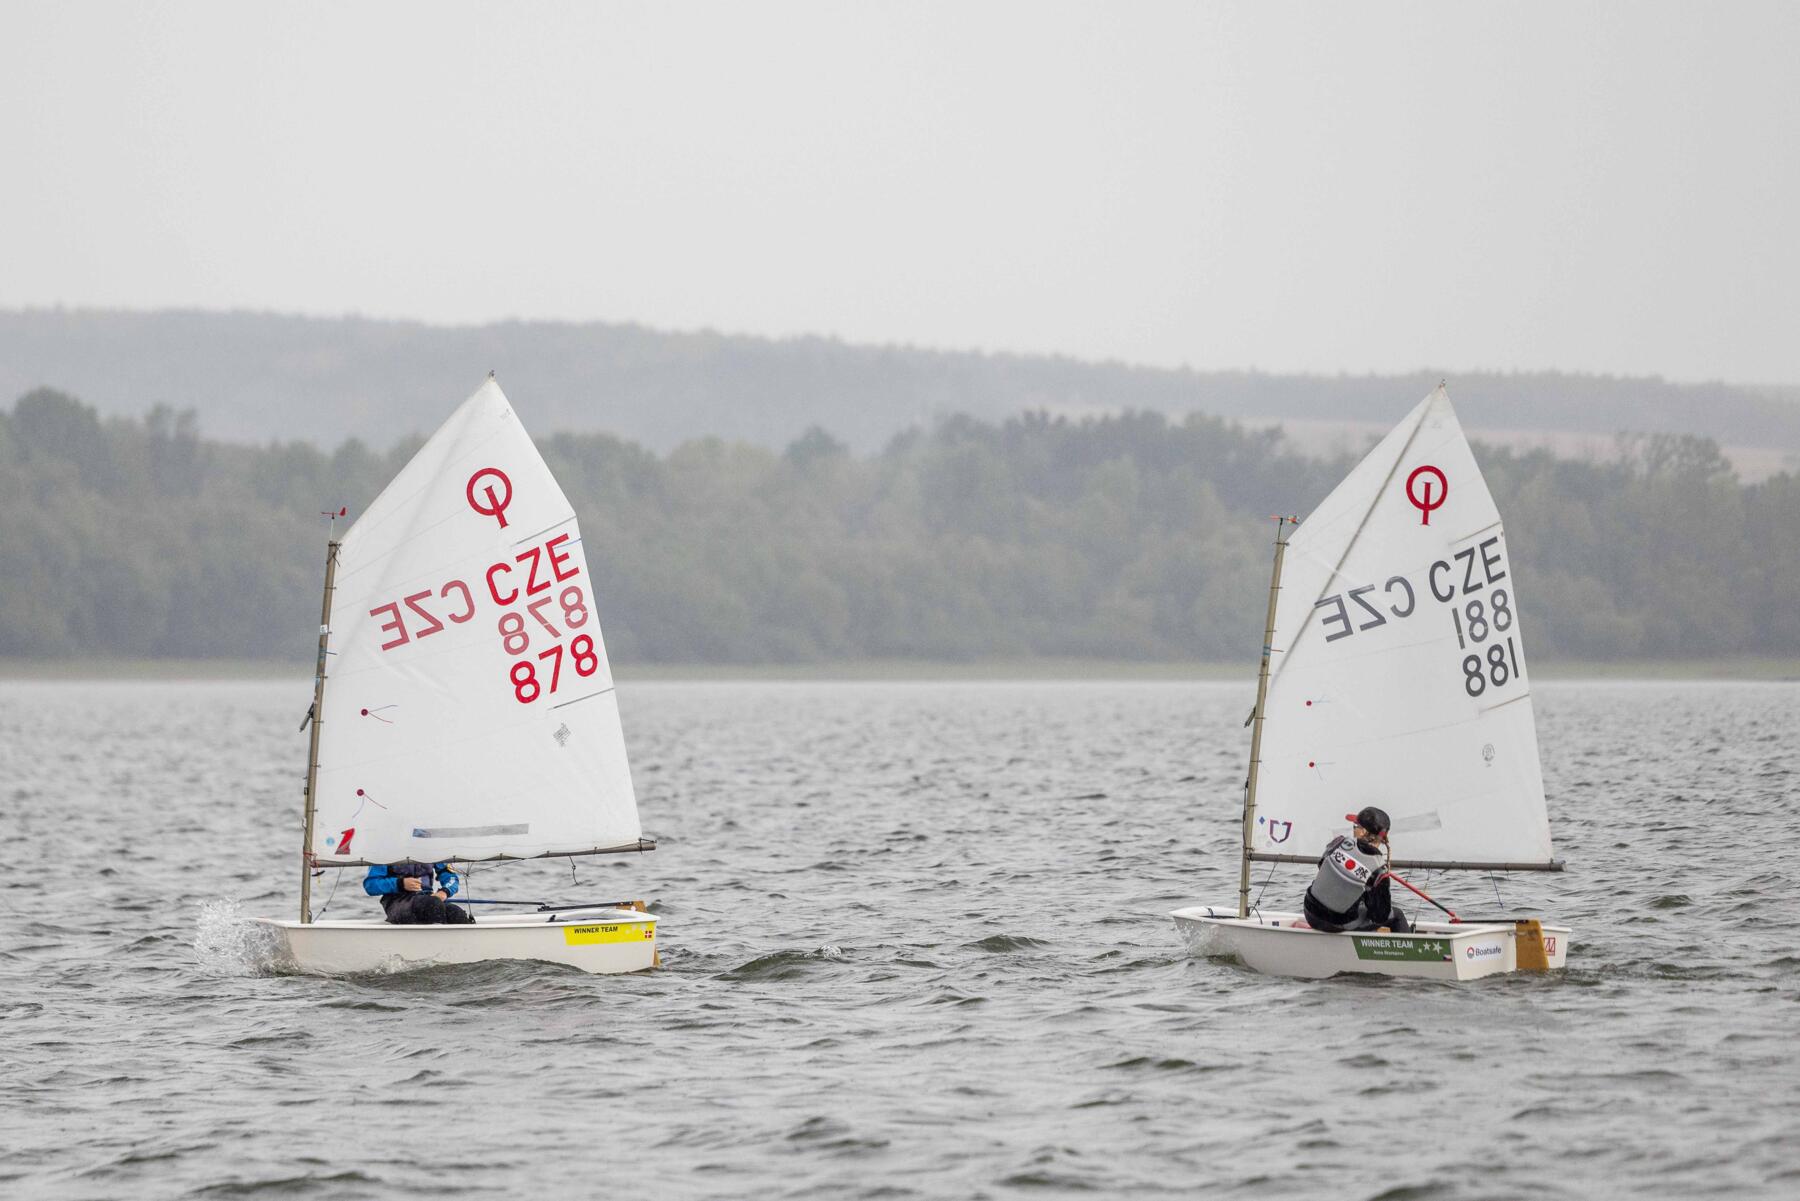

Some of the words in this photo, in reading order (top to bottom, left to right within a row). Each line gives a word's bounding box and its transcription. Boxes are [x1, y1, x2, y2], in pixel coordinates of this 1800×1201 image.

[485, 532, 580, 606] CZE
[1429, 535, 1506, 603] CZE
[509, 633, 598, 704] 878
[1463, 636, 1519, 698] 881
[574, 926, 600, 934] WINNER
[600, 925, 619, 933] TEAM
[1360, 938, 1391, 948] WINNER
[1392, 940, 1414, 949] TEAM
[1475, 945, 1502, 957] Boatsafe
